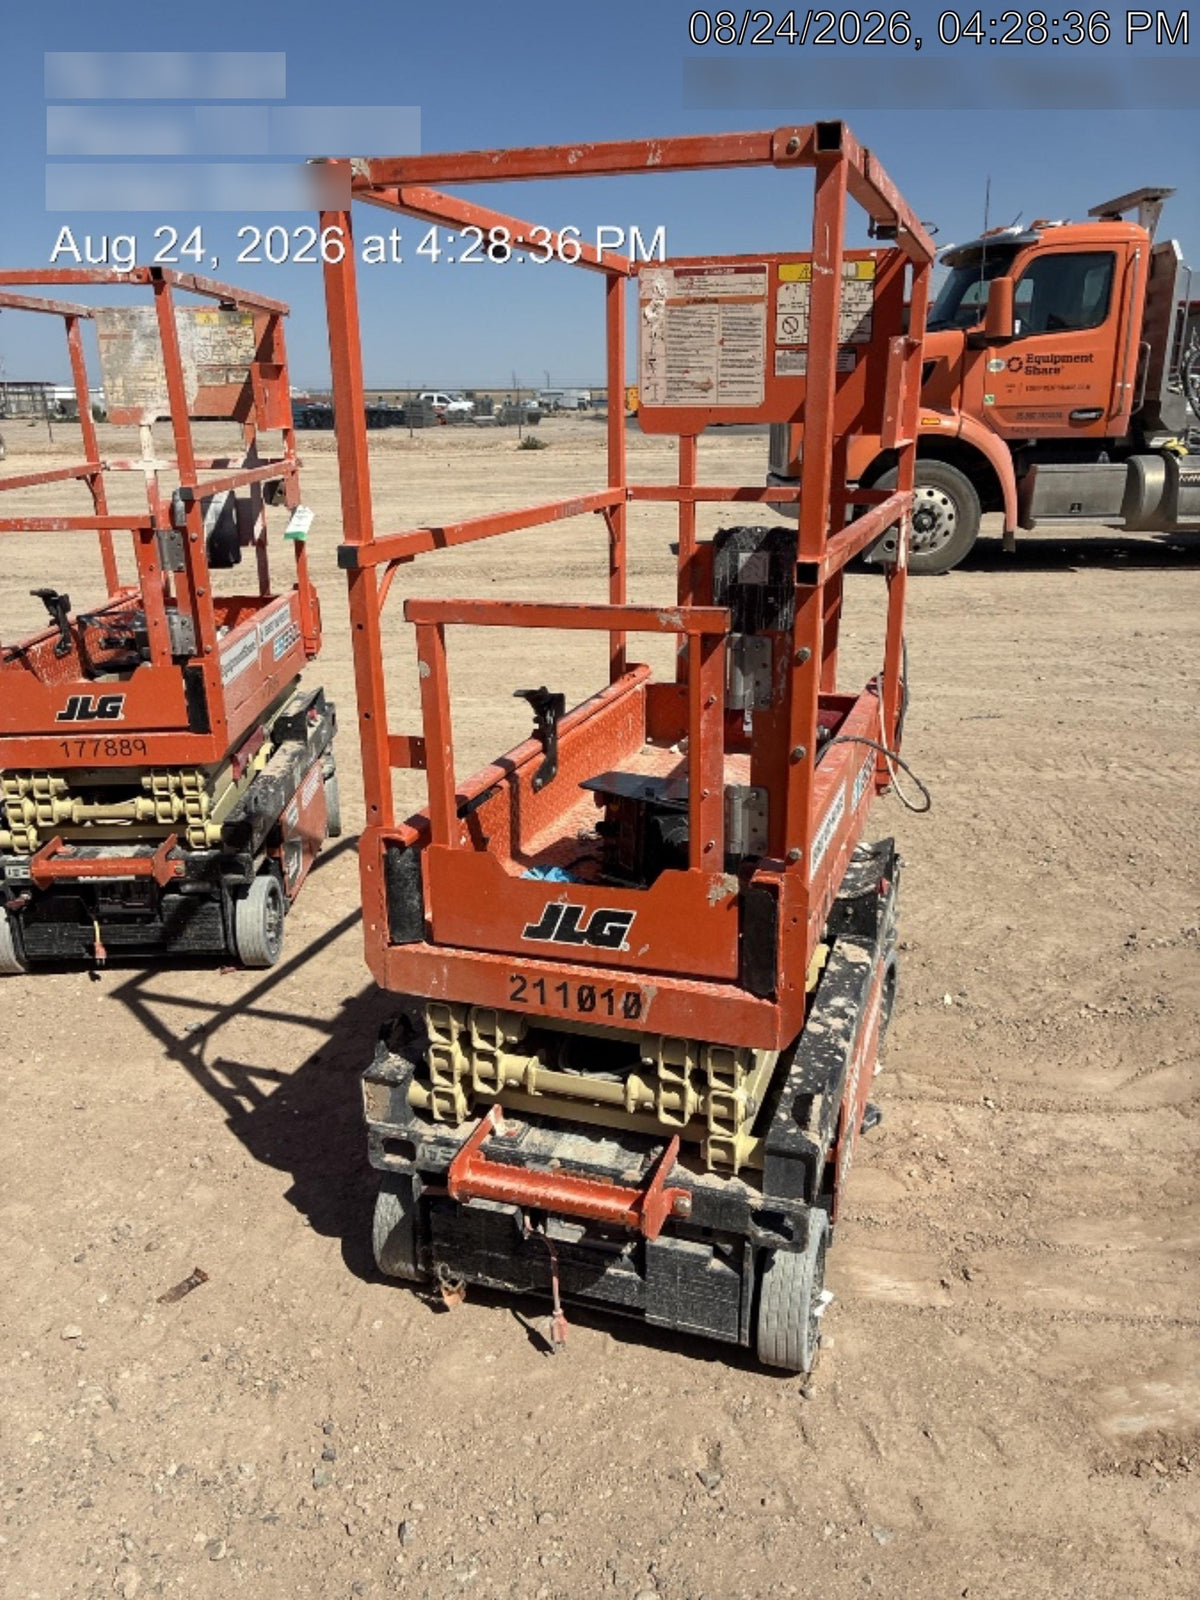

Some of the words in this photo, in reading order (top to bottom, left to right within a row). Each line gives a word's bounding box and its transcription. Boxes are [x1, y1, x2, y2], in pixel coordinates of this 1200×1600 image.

[1024, 365, 1062, 376] Share
[1025, 352, 1094, 365] Equipment
[54, 692, 125, 723] JLG
[58, 737, 148, 760] 177889
[520, 901, 637, 952] JLG
[508, 972, 643, 1020] 211010
